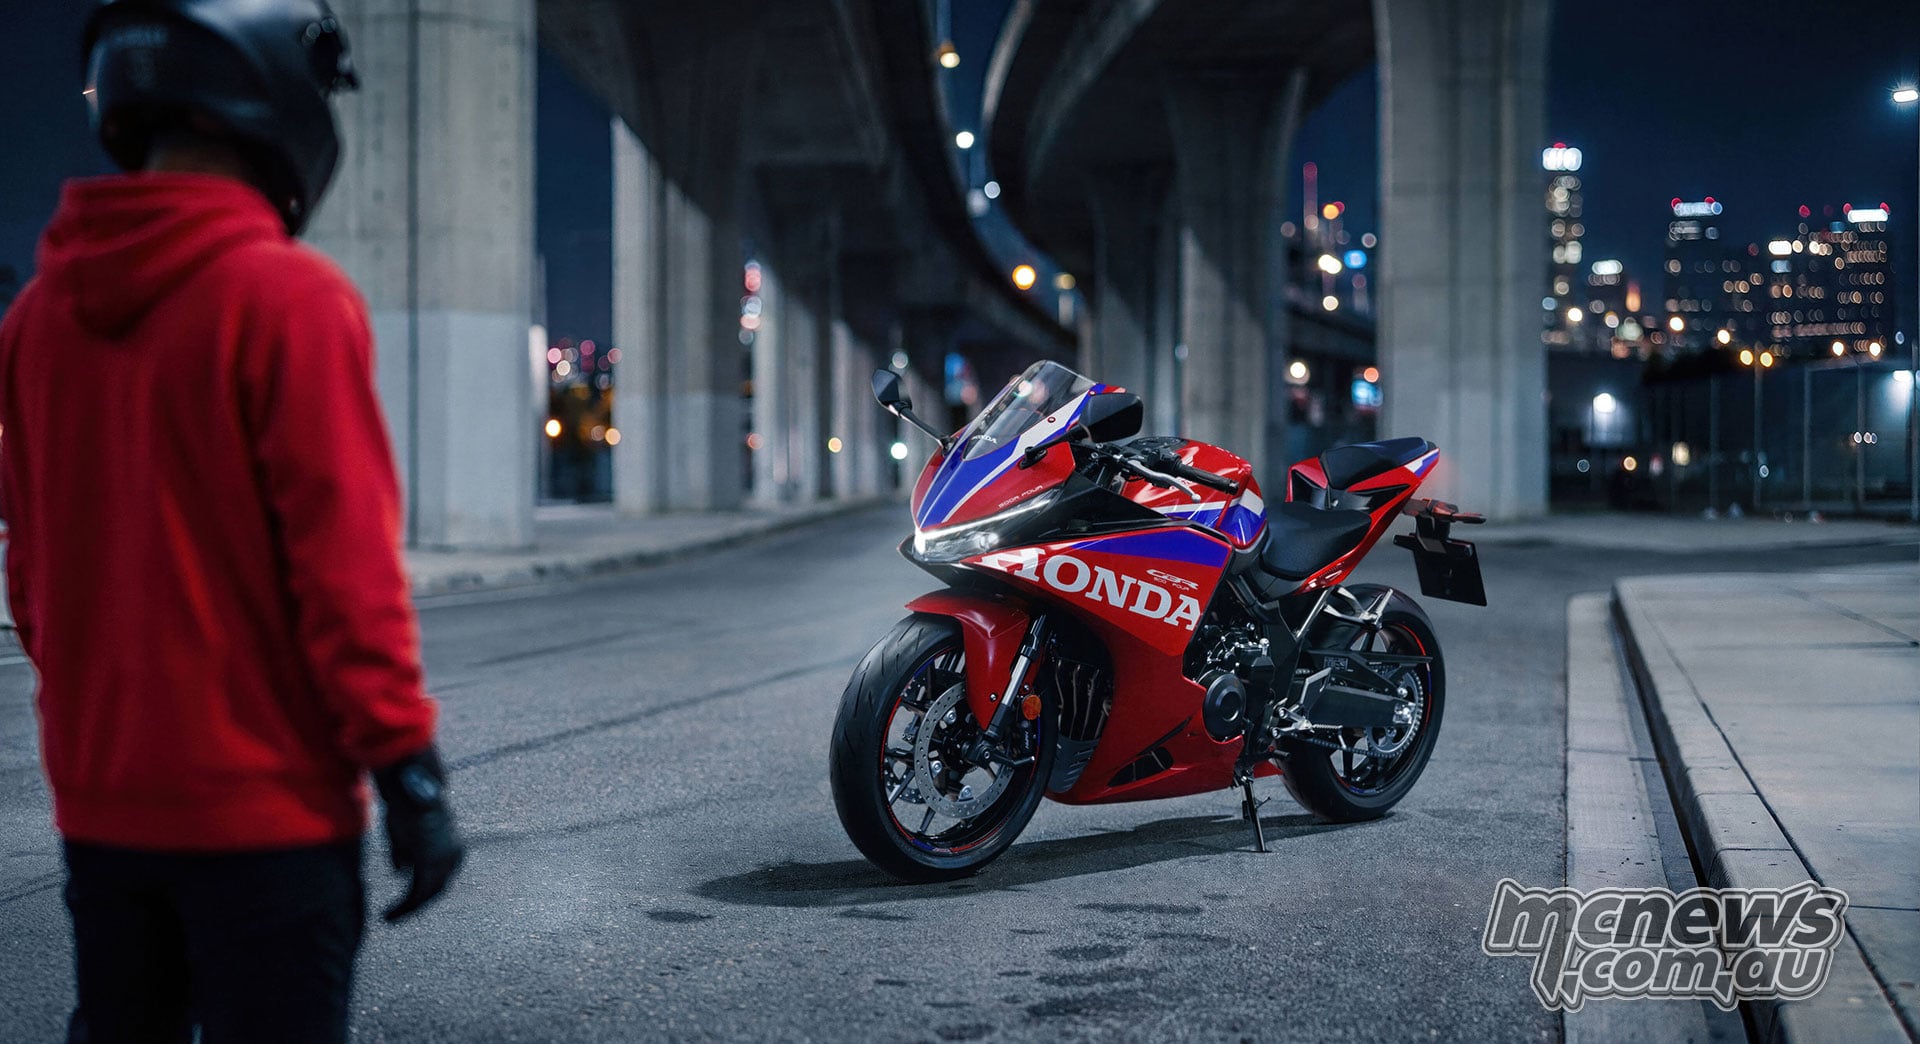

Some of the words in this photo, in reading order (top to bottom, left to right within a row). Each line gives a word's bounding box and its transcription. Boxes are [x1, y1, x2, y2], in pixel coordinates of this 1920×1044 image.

[1021, 485, 1044, 497] FOUR
[974, 547, 1201, 631] HONDA
[1146, 568, 1199, 590] CBR
